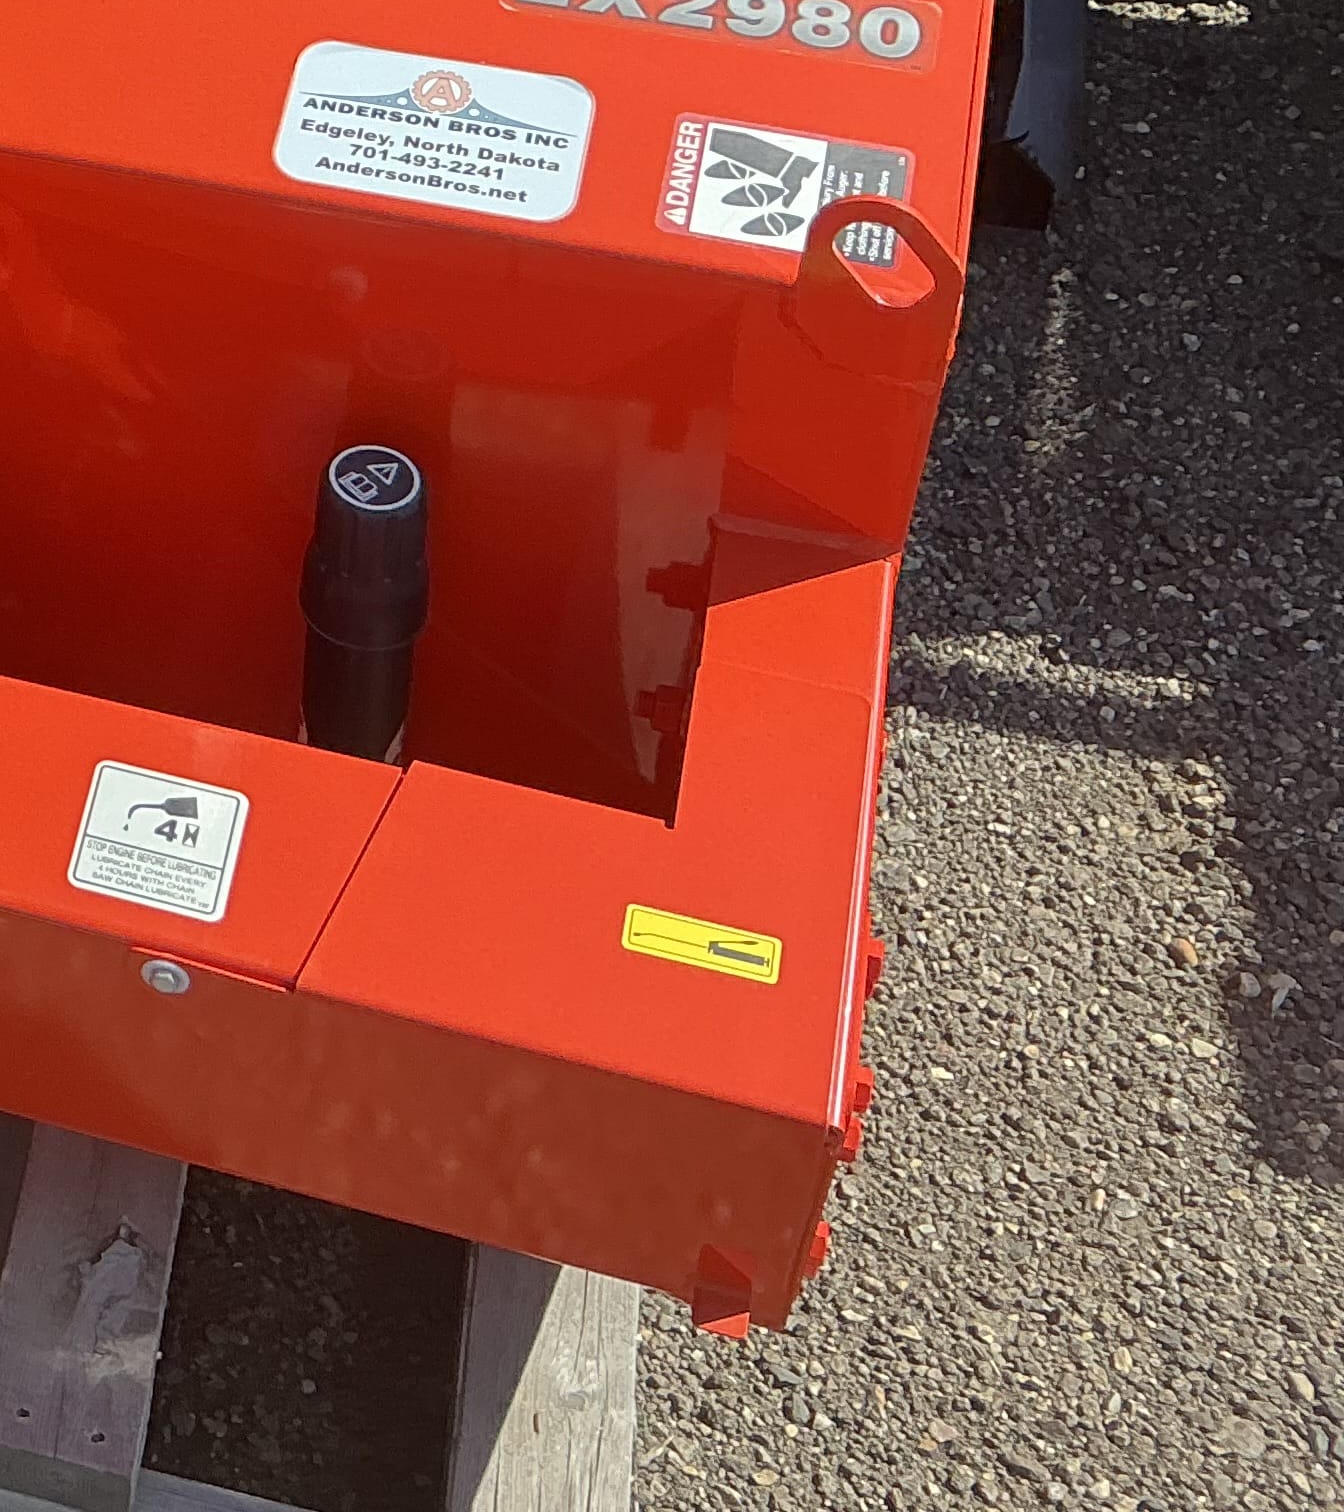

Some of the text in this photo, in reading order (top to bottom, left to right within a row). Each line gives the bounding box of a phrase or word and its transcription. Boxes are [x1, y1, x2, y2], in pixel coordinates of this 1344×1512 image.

[302, 96, 570, 149] ANDERSON BROS INC
[299, 118, 561, 172] Edgeley, North Dakota
[349, 143, 505, 181] 701-493-2241
[665, 121, 704, 207] DANGER
[314, 155, 529, 203] AndersonBros.net
[86, 838, 217, 881] STOP ENGINE BEFORE LUBRICATING
[91, 853, 207, 889] LUBRICATE CHAIN EVERY
[105, 866, 138, 880] HOURS
[140, 875, 165, 887] WITH
[166, 881, 195, 895] CHAIN
[92, 871, 114, 883] SAW
[115, 877, 144, 891] CHAIN
[145, 884, 197, 905] LUBRICATE
